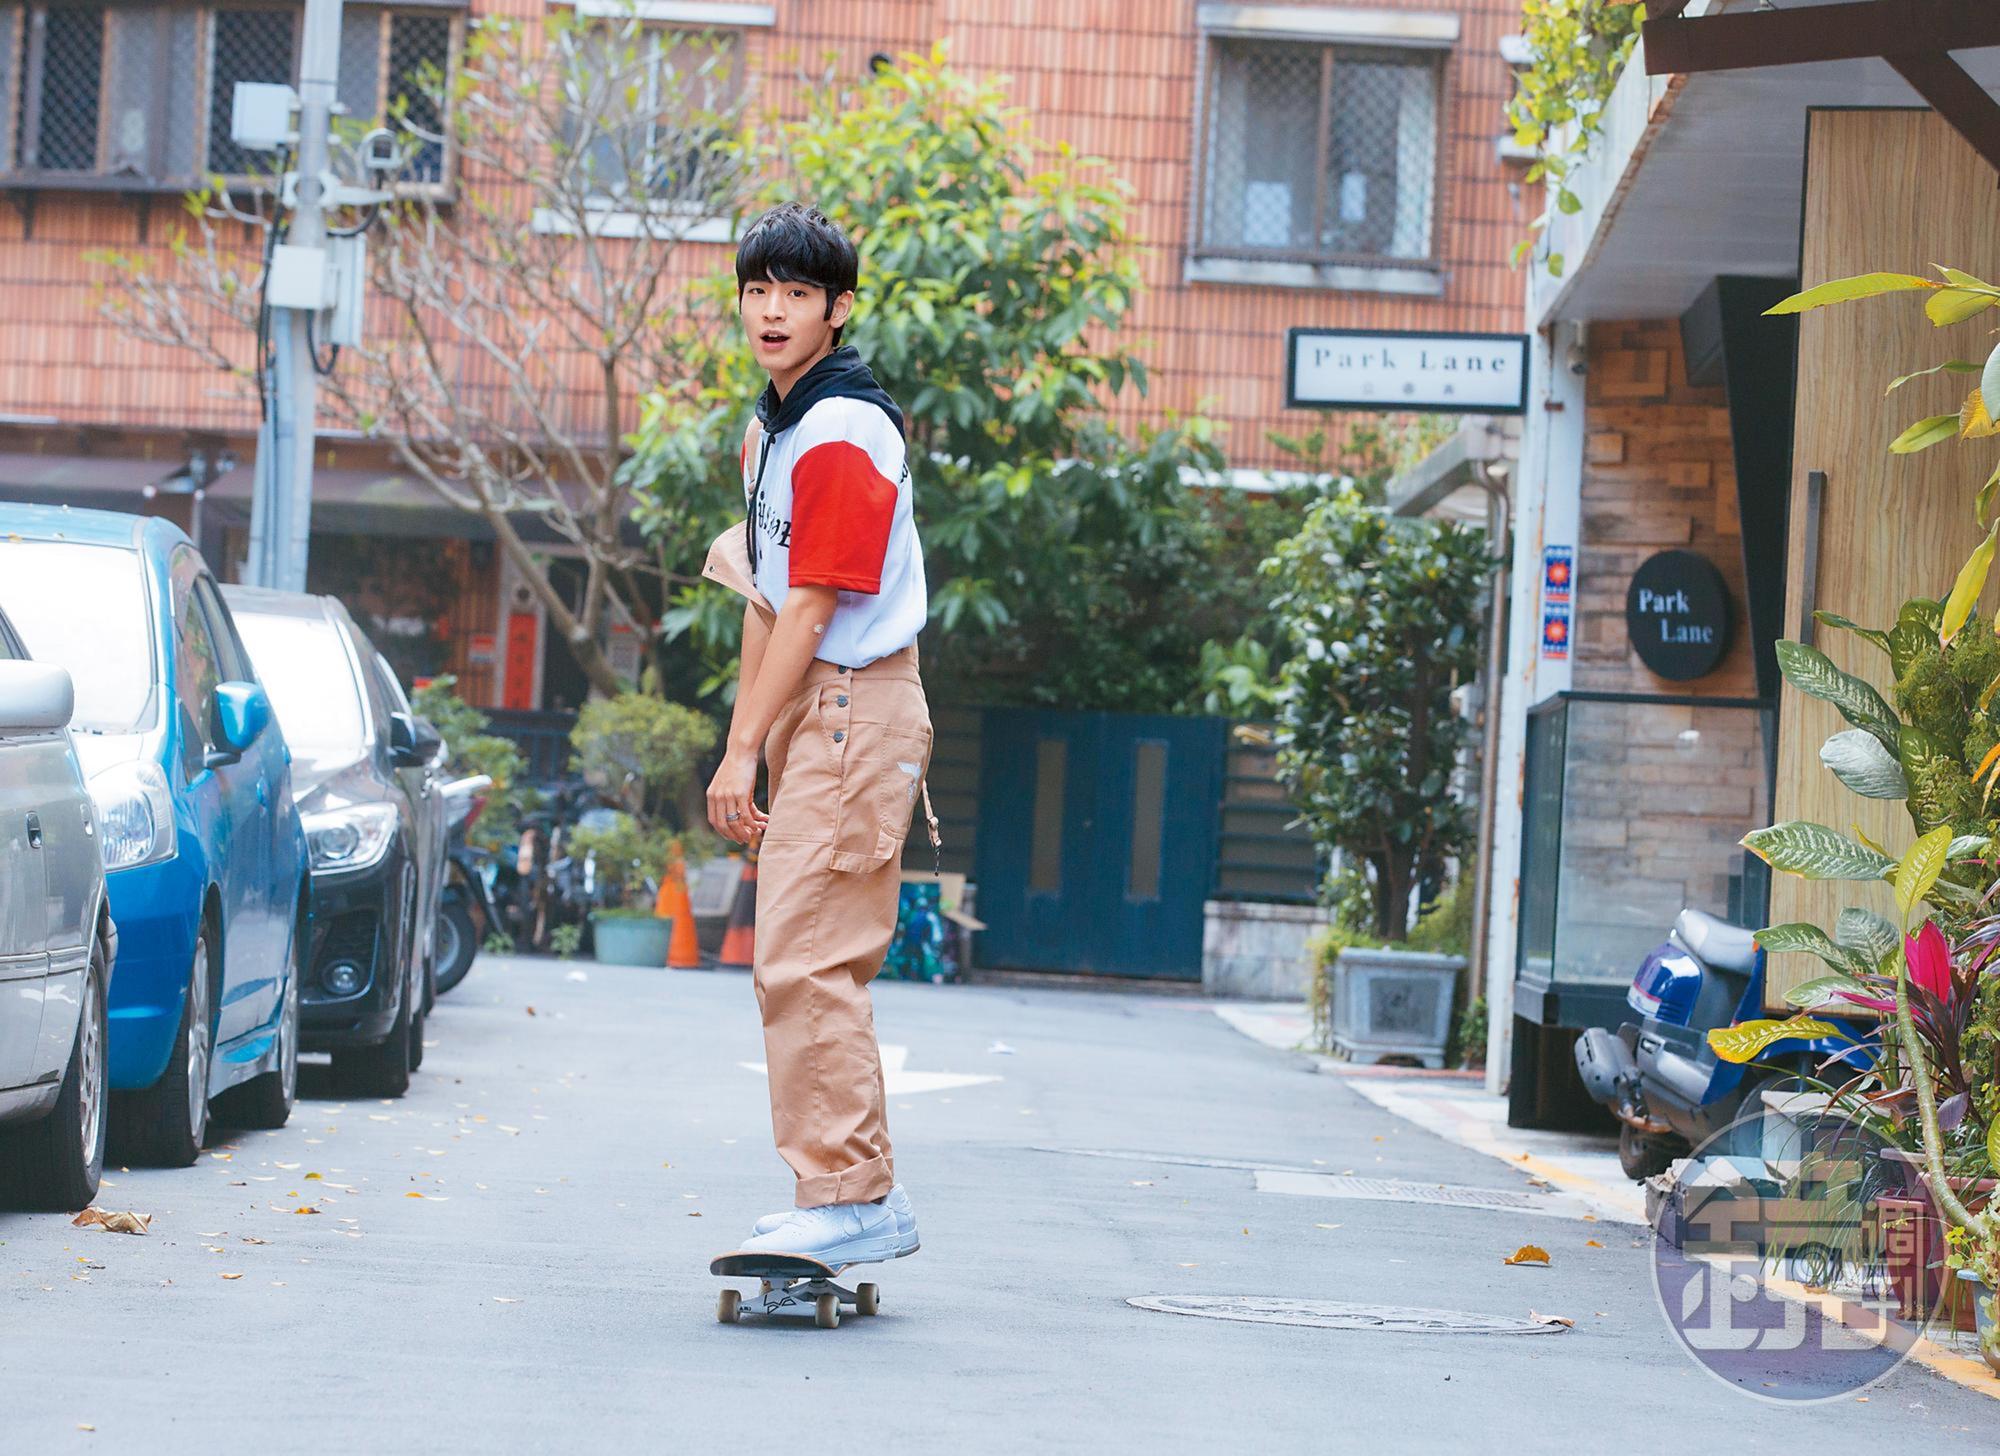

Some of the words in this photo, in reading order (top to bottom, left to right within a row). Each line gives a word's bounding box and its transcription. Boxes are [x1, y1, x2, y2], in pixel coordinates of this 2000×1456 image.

[1314, 348, 1397, 369] Park
[1420, 350, 1506, 372] Lane
[1639, 588, 1690, 613] Park
[1661, 618, 1713, 643] Lane
